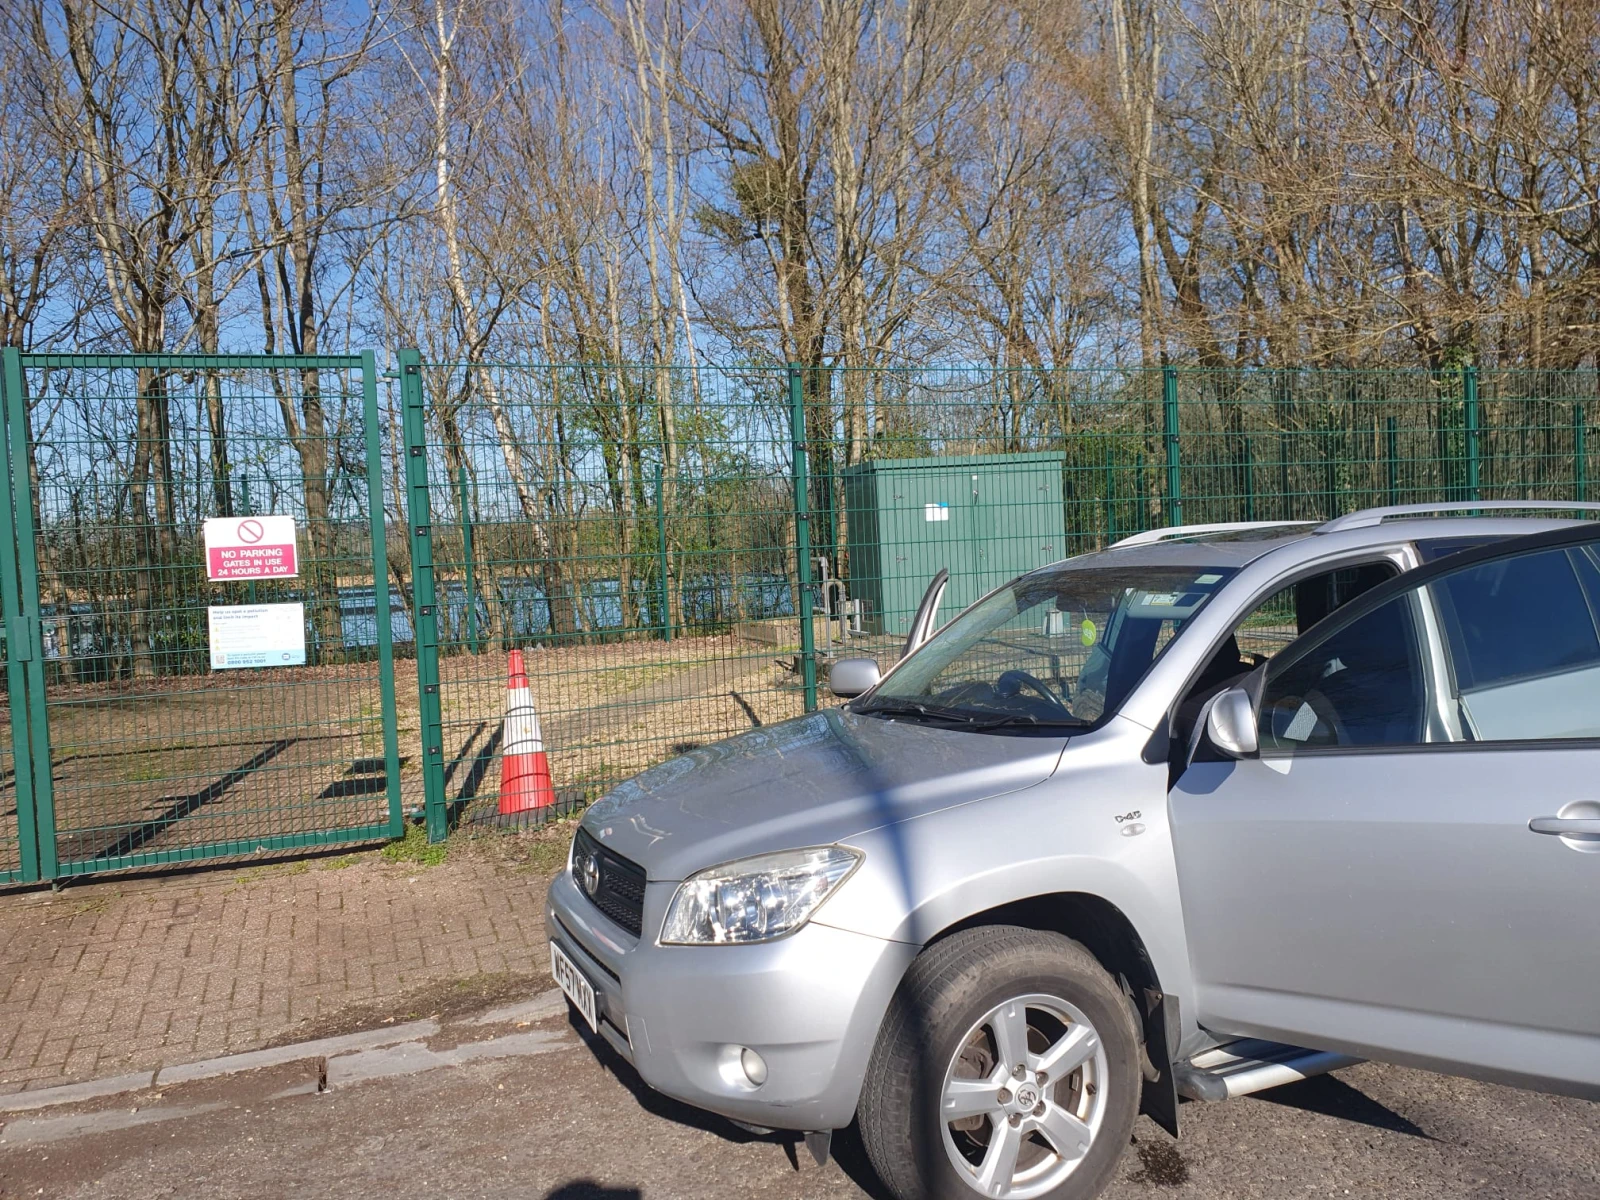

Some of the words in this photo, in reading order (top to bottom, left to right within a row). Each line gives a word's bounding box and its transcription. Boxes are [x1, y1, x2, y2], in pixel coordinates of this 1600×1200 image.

[221, 550, 236, 559] NO
[240, 548, 283, 558] PARKING
[223, 559, 250, 568] GATES
[265, 558, 282, 566] USE
[231, 567, 260, 575] HOURS
